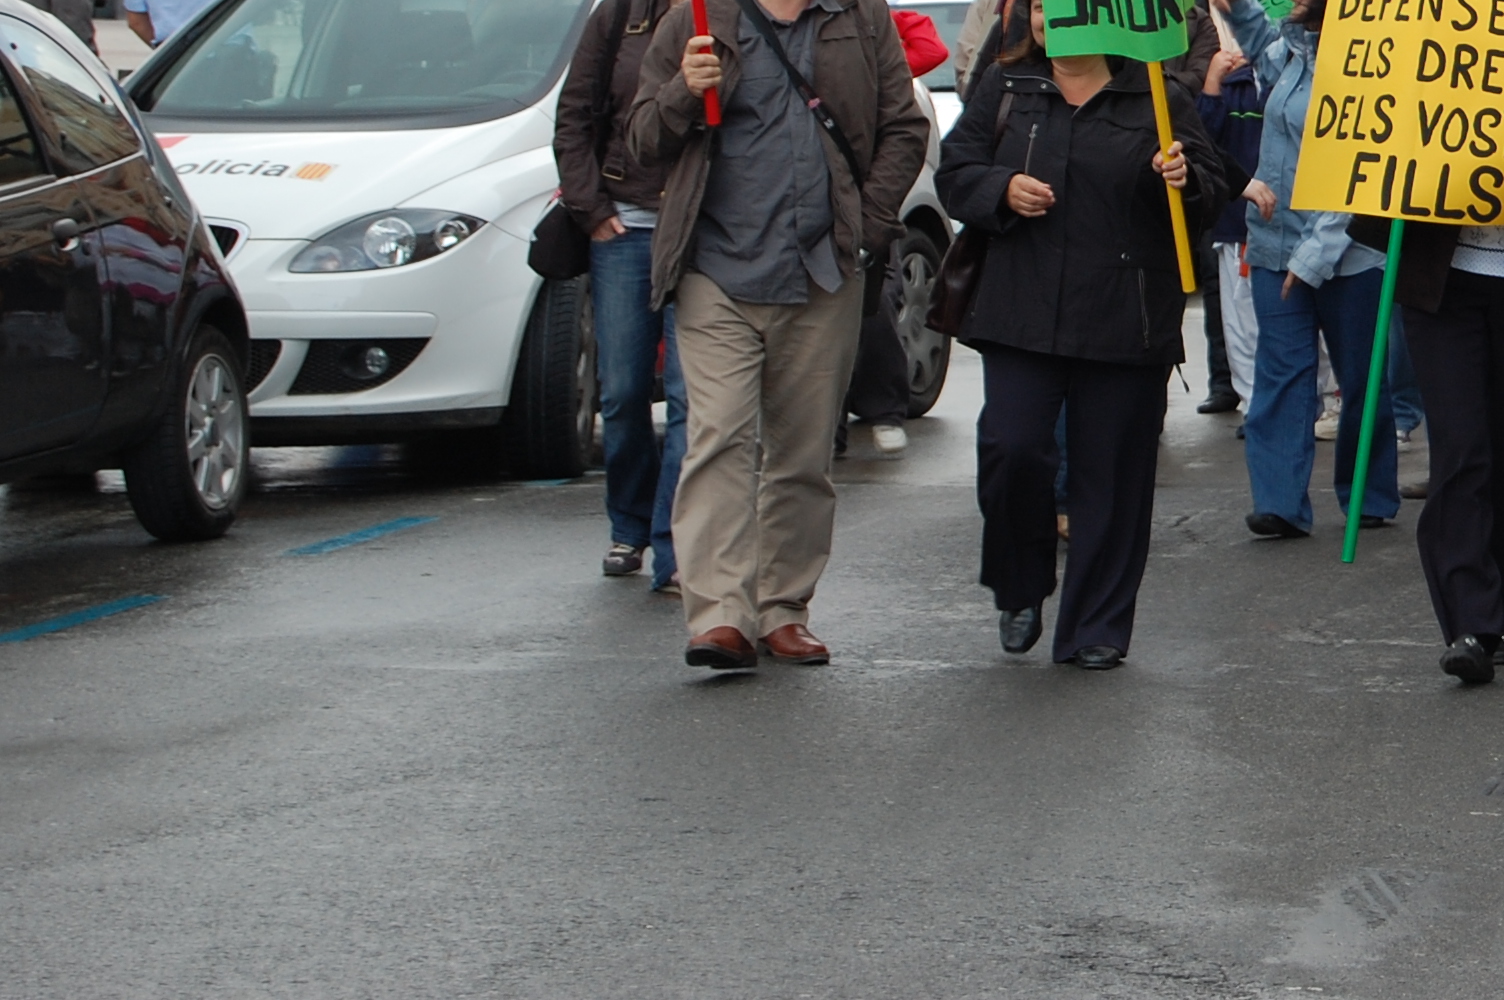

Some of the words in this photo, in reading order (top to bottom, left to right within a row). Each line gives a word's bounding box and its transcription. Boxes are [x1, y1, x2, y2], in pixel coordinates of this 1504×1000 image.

[1343, 37, 1394, 79] ELS
[1315, 94, 1396, 144] DELS
[175, 159, 290, 176] olicia
[1345, 151, 1504, 224] FILLS
